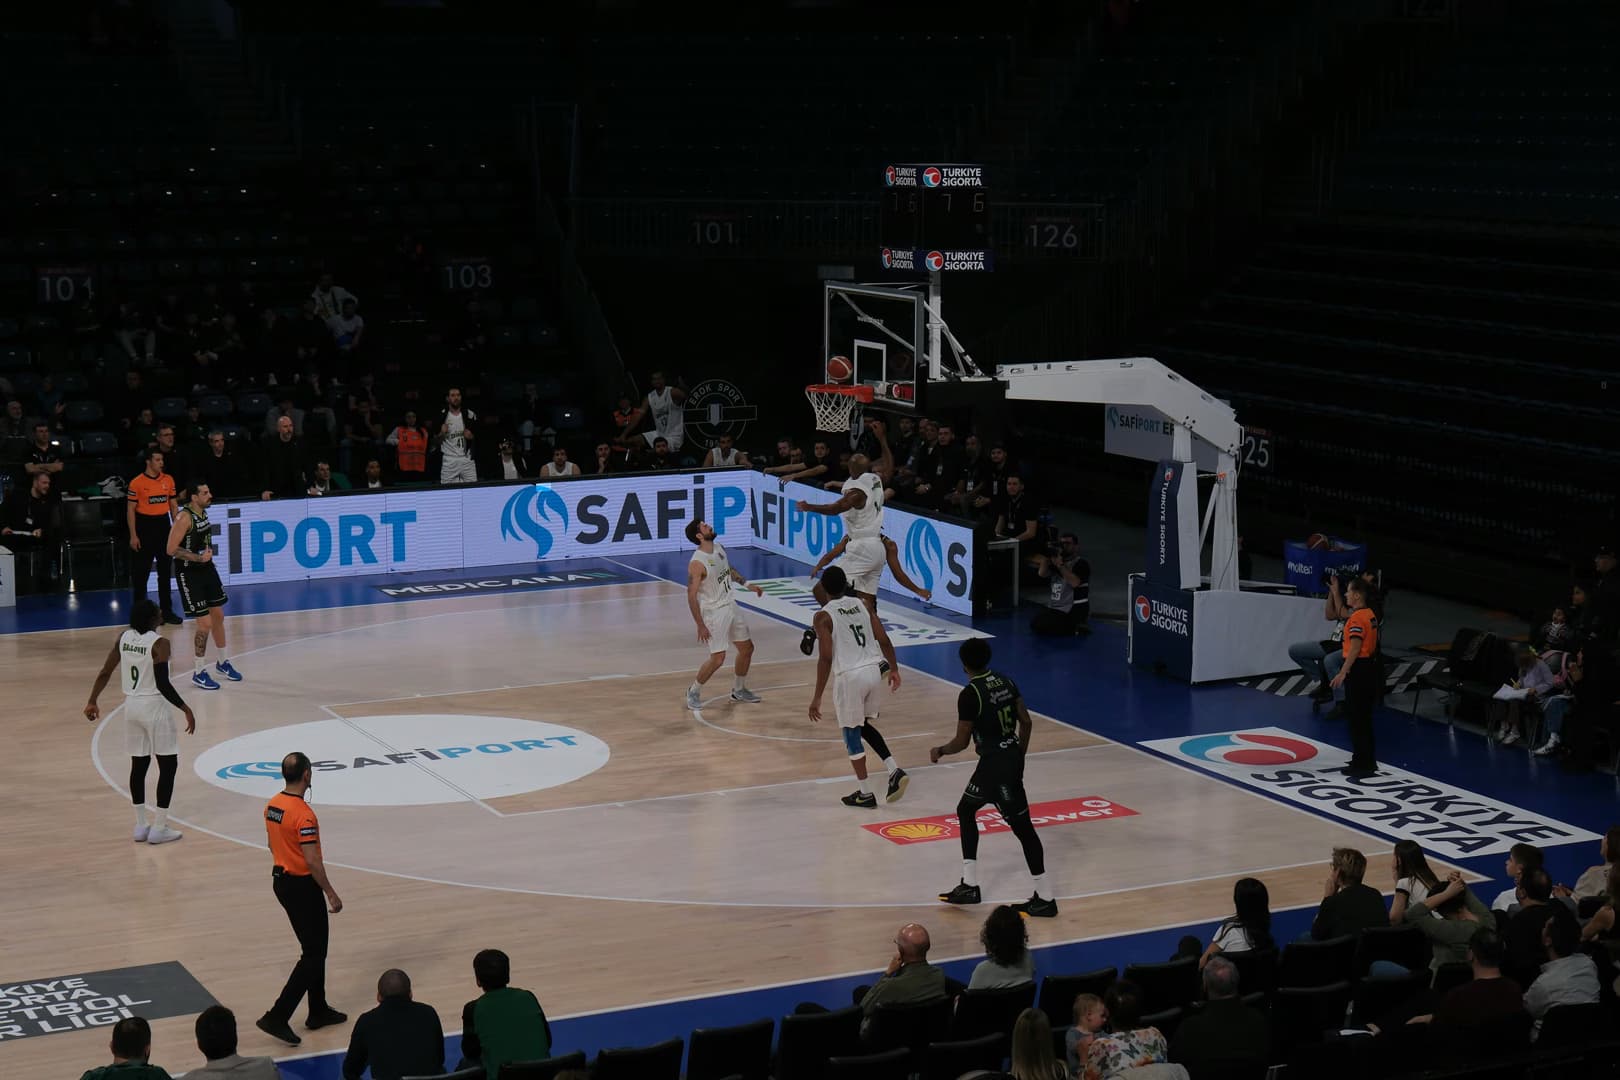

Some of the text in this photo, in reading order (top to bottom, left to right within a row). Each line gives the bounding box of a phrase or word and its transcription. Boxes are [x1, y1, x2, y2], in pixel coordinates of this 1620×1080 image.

[690, 221, 734, 245] 101
[1029, 224, 1078, 248] 126
[446, 264, 492, 289] 103
[689, 383, 741, 405] EROK SPOR
[381, 574, 593, 596] MEDICANA
[849, 624, 865, 648] 15
[131, 665, 139, 690] 9
